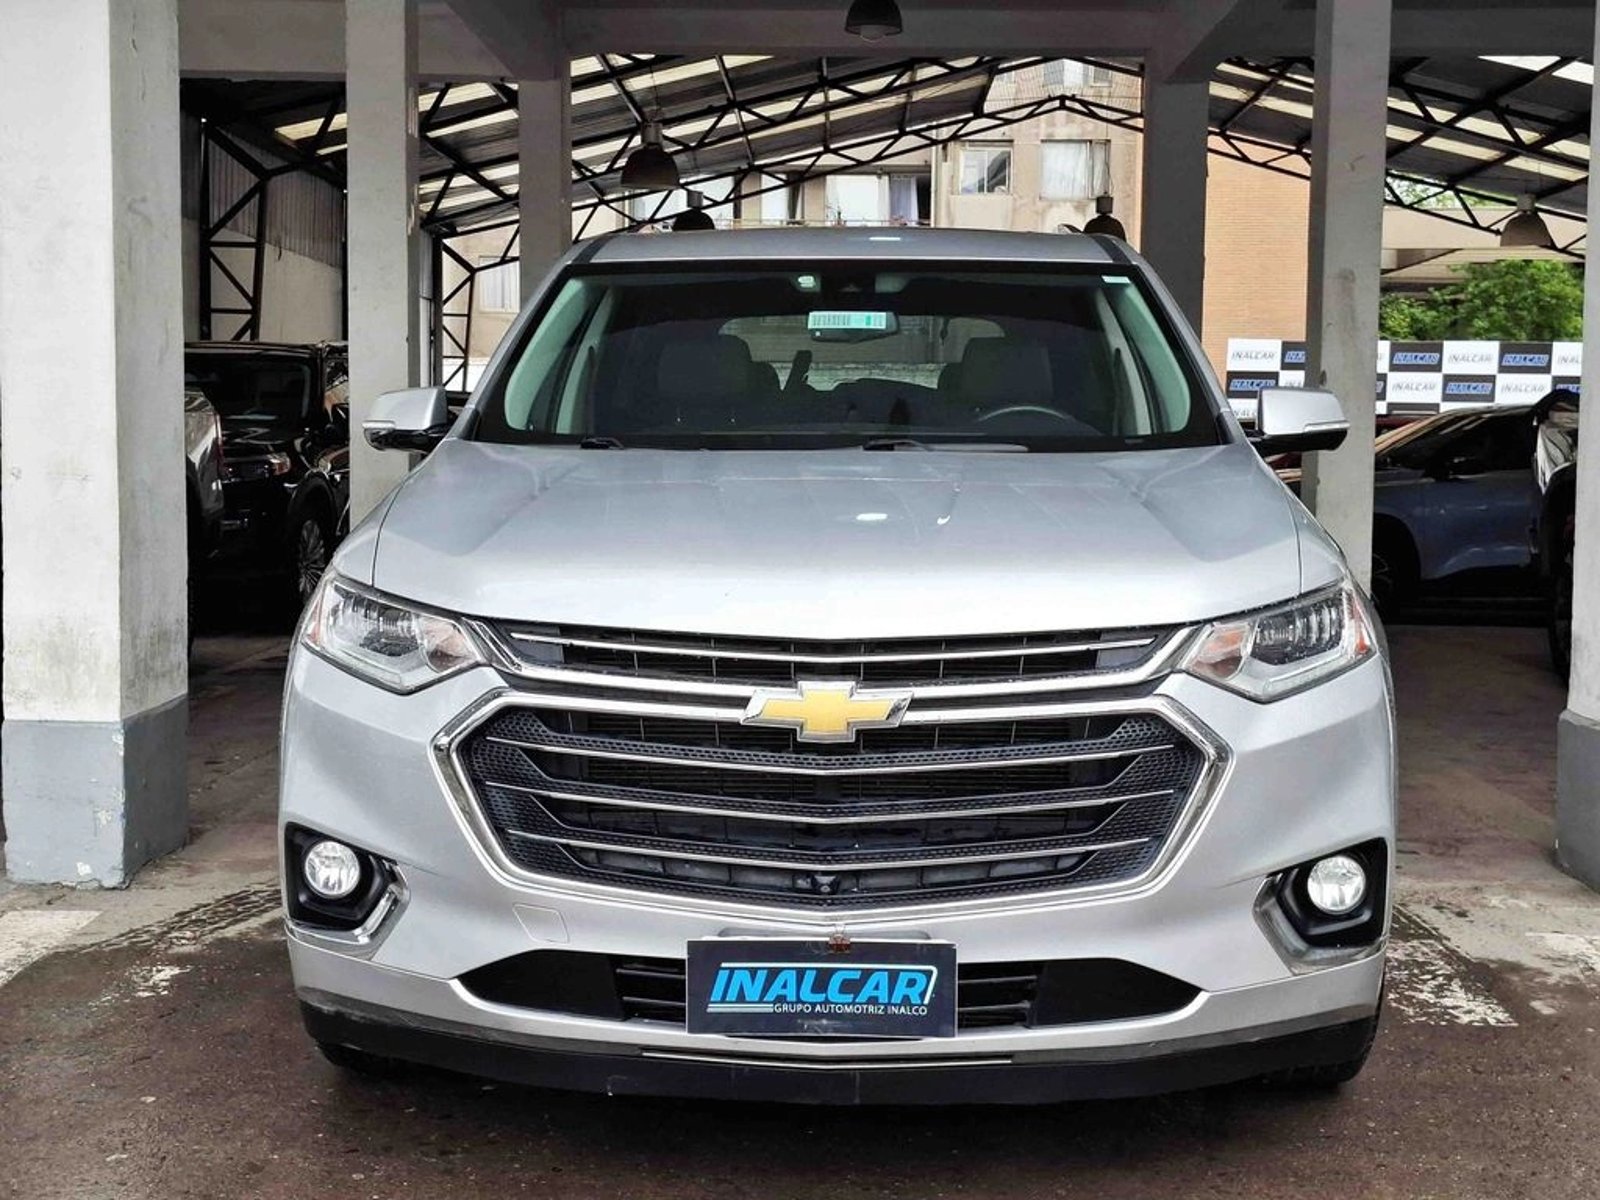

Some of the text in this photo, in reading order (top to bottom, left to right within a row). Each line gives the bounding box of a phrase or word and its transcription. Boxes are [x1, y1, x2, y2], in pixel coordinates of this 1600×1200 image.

[1394, 353, 1438, 363] INALCAR
[1448, 354, 1493, 362] INALCAR
[1502, 355, 1547, 365] INALCAR
[1558, 355, 1582, 364] INAL
[1391, 382, 1436, 392] INALCAR
[1447, 383, 1492, 394] INALCAR
[1501, 384, 1546, 393] INALCAR
[711, 969, 928, 1004] INALCAR
[774, 1003, 928, 1015] GRUPO AUTOMOTRIZ INALCO
